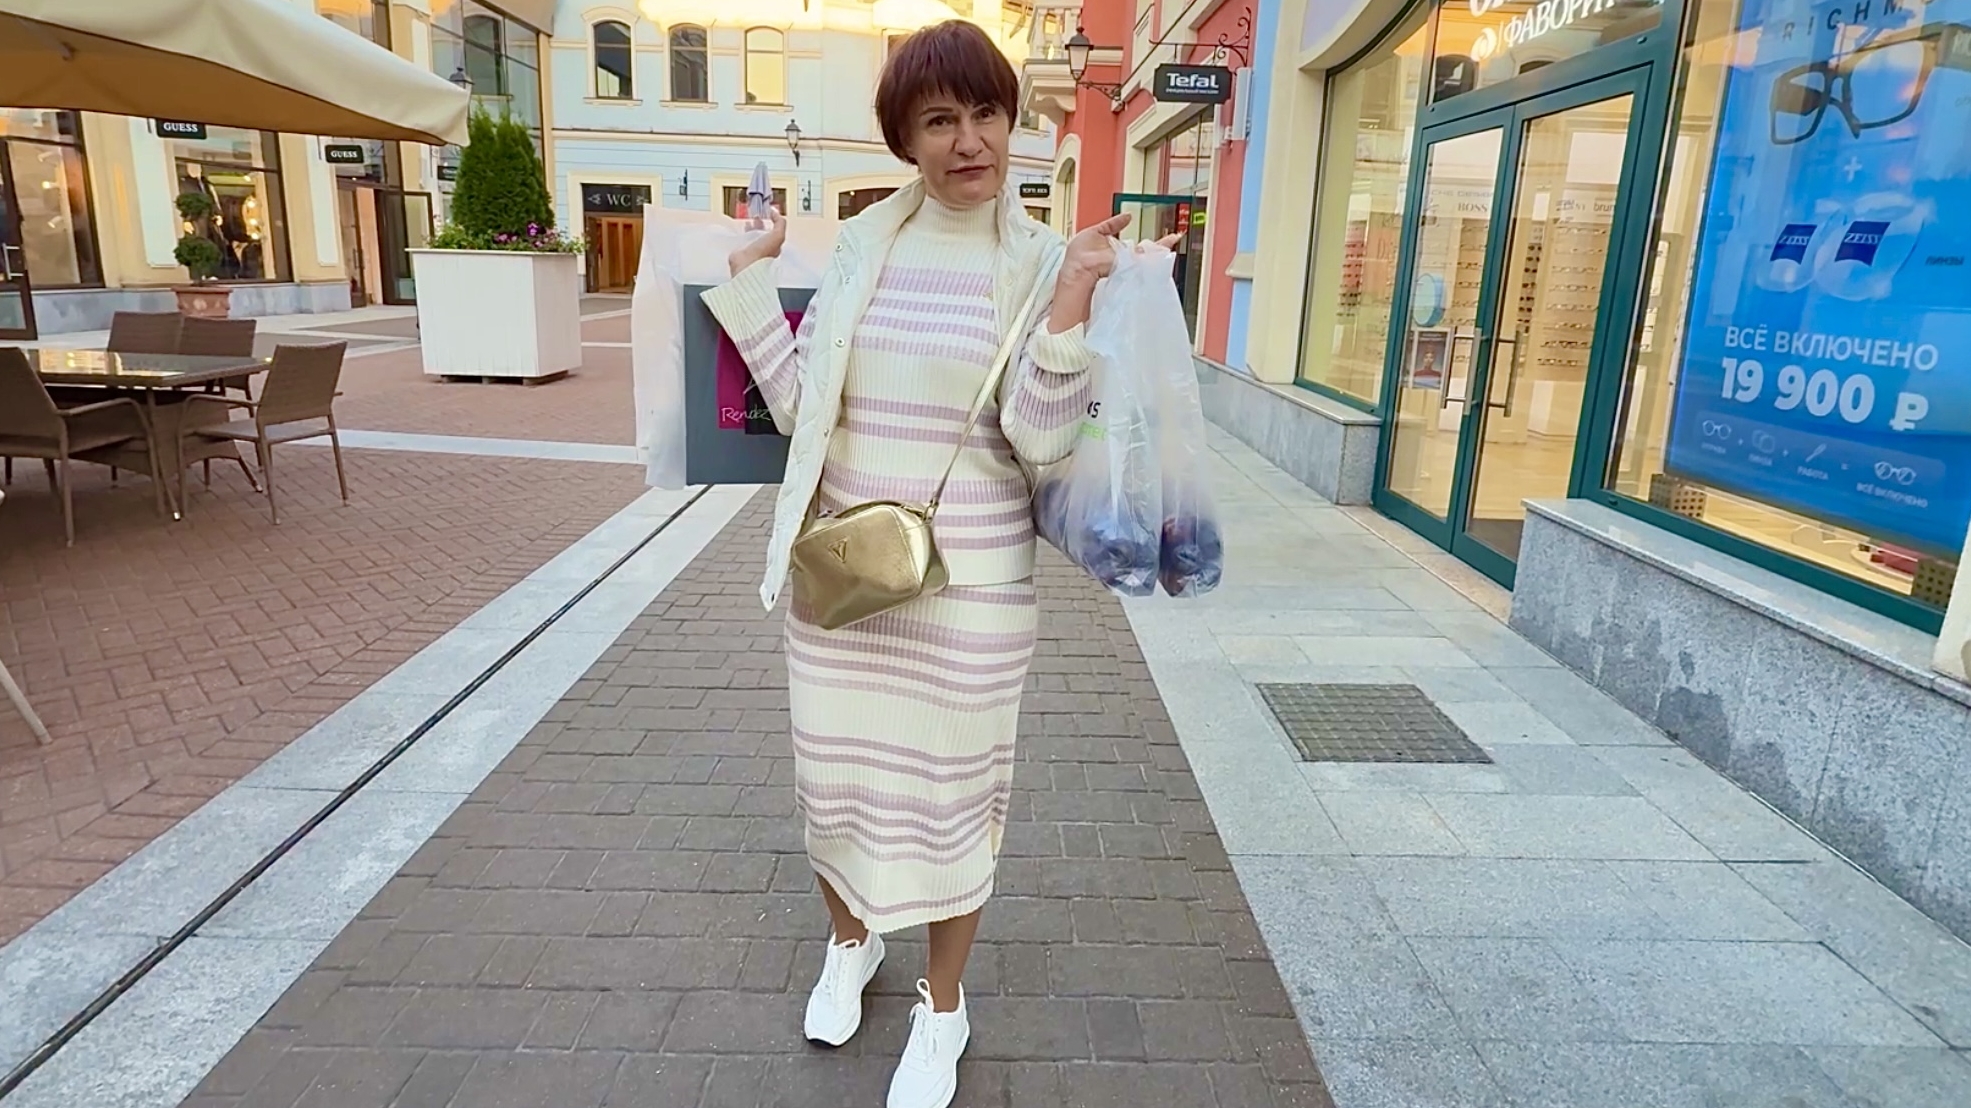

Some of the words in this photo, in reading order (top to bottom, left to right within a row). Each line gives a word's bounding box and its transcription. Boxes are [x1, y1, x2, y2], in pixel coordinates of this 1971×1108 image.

[1166, 73, 1219, 88] Tefal
[163, 122, 198, 132] GUESS
[330, 150, 358, 158] GUESS
[606, 193, 631, 206] WC
[1458, 203, 1487, 212] BOSS
[1844, 233, 1881, 245] ZEISS
[1724, 324, 1768, 351] ВСЁ
[1773, 331, 1939, 371] ВКЛЮЧЕНО
[1721, 356, 1764, 403] 19
[1774, 365, 1875, 424] 900
